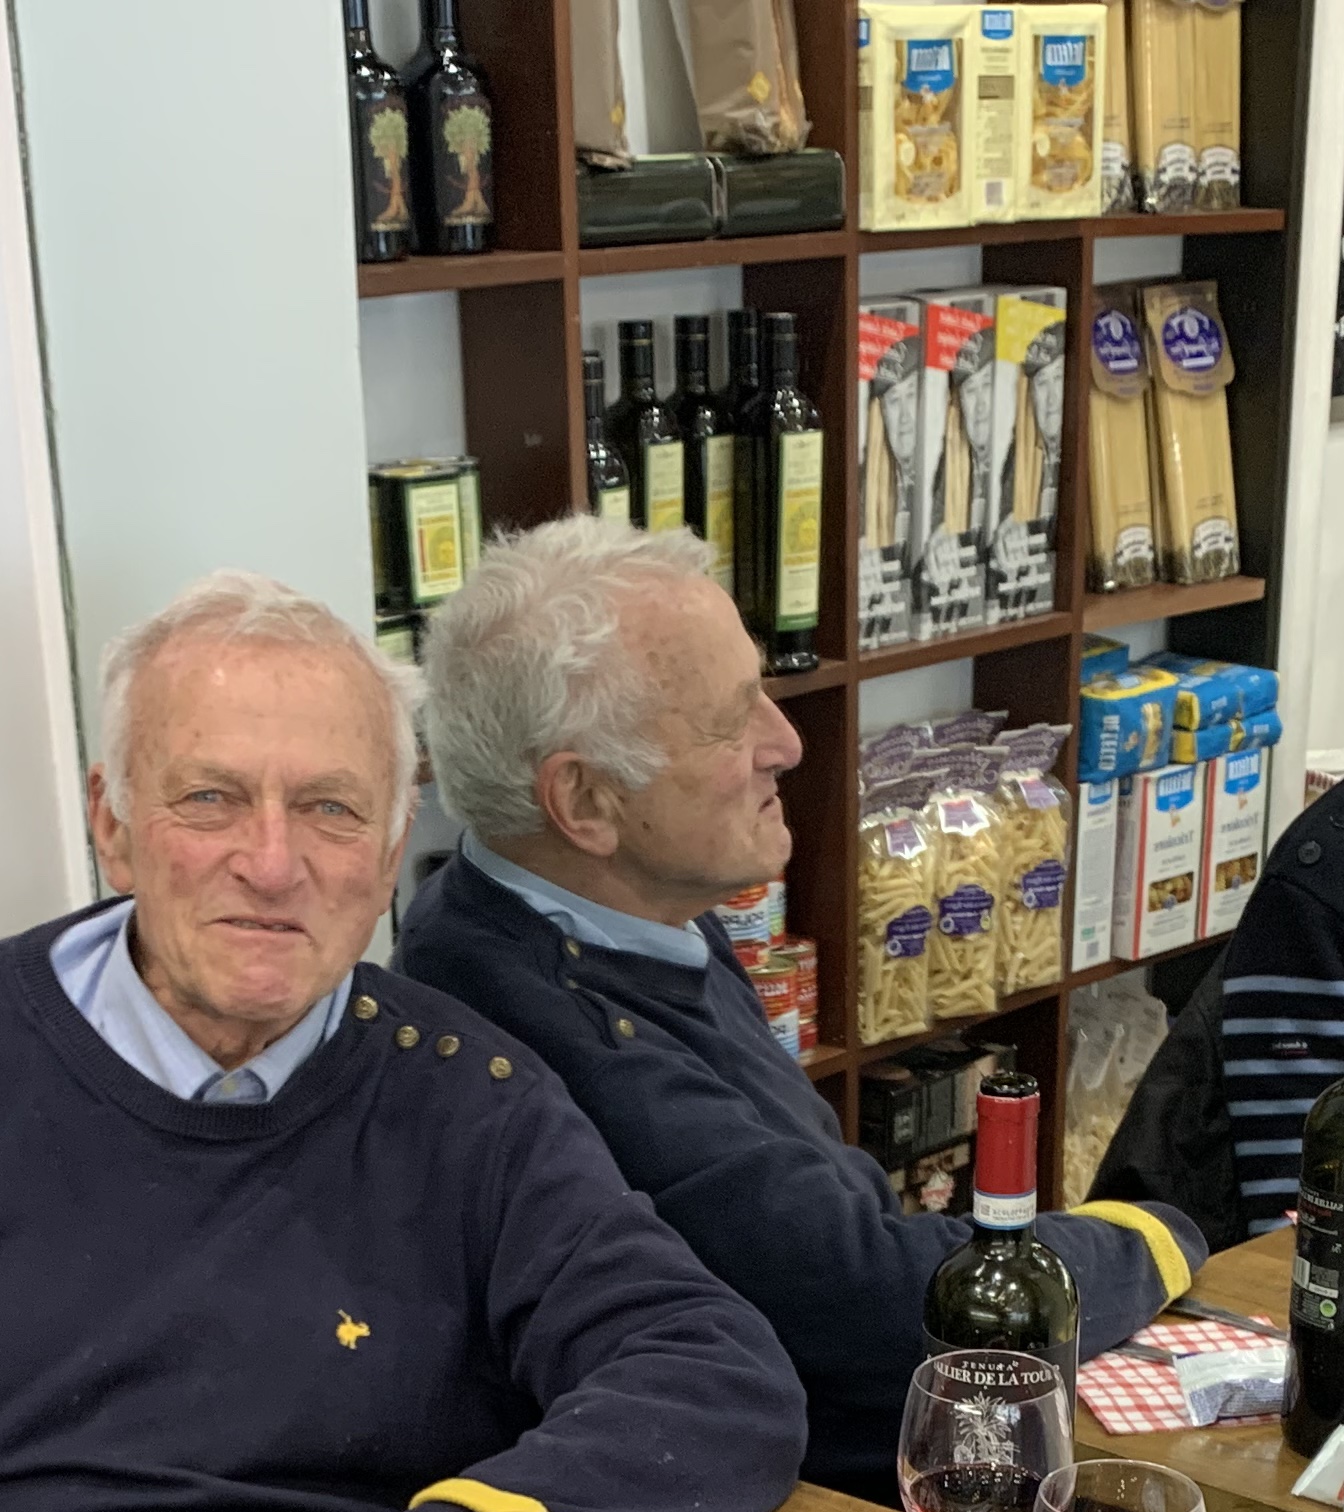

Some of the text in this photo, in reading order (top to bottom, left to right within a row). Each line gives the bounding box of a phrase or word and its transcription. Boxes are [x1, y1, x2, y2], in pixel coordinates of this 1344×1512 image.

[926, 1354, 972, 1385] ALLIER
[975, 1371, 996, 1386] DE
[998, 1372, 1020, 1386] LA
